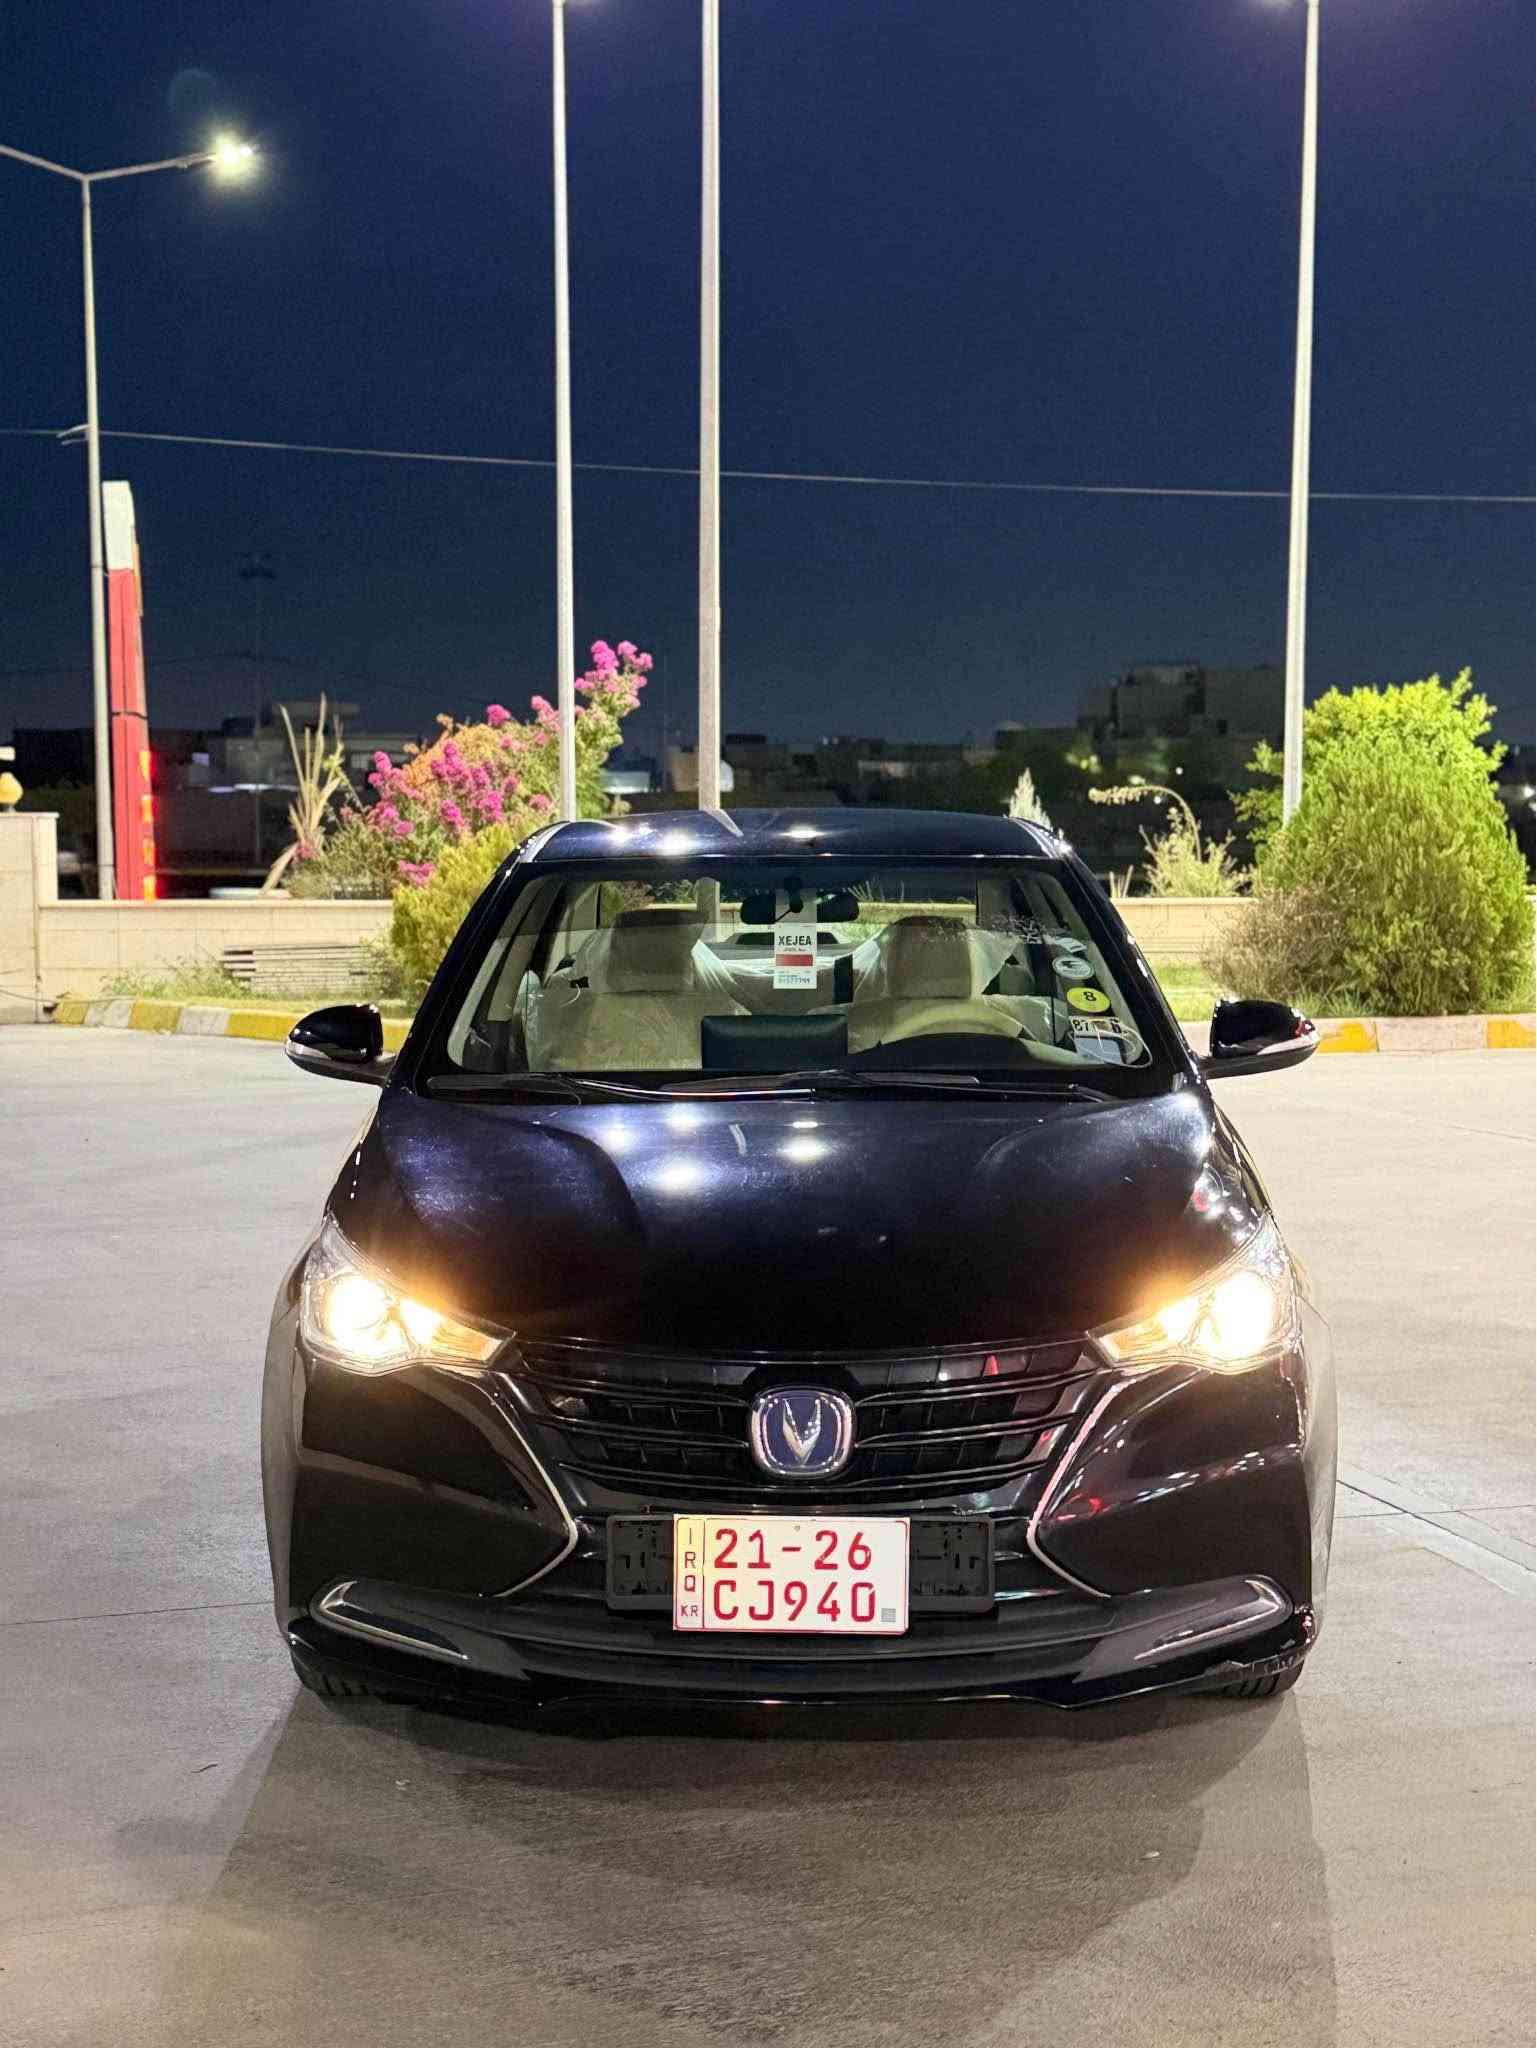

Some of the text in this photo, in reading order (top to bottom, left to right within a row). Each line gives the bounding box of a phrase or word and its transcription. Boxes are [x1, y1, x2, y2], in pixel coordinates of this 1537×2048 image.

[714, 1528, 872, 1570] 21-26
[681, 1605, 699, 1617] KR
[713, 1580, 876, 1622] CJ940
